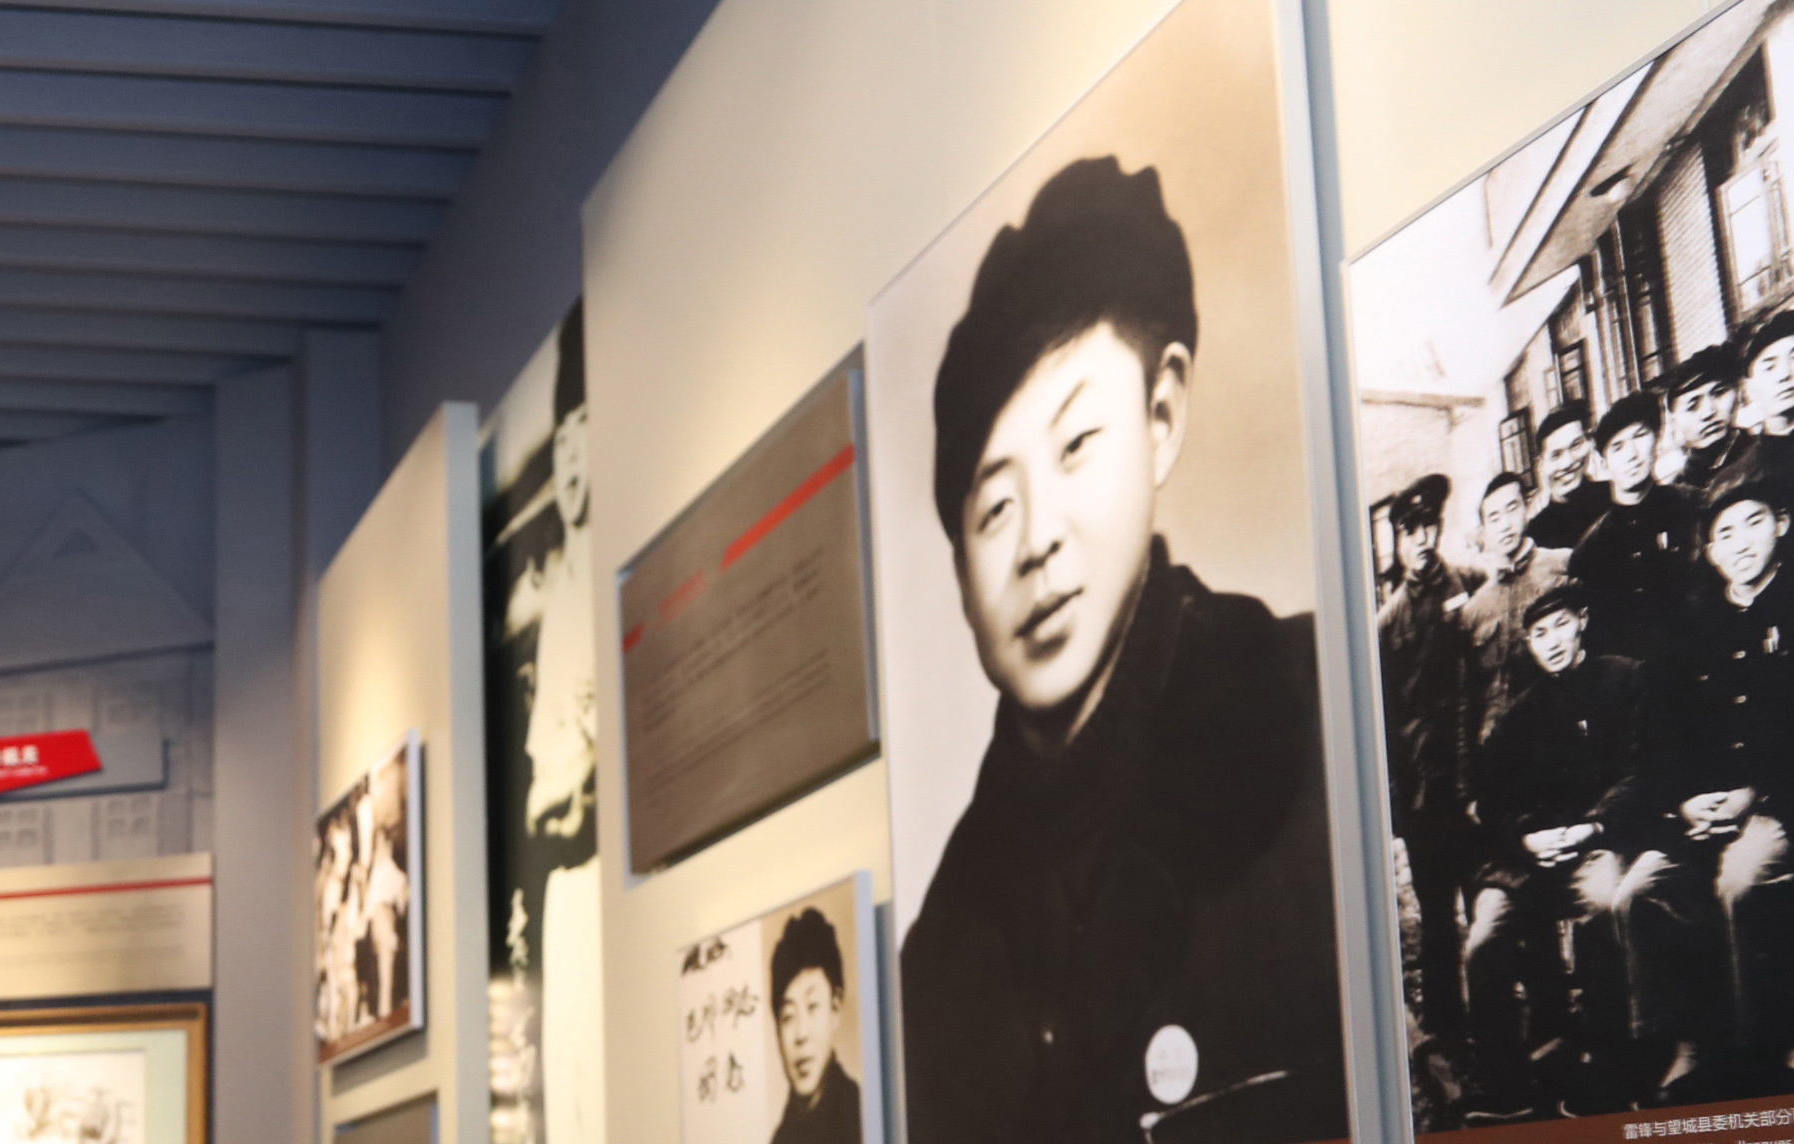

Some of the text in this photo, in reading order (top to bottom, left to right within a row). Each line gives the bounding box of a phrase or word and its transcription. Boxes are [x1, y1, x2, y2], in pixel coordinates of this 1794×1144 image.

[1623, 1107, 1794, 1140] 雷锋与望城县委机关部分
